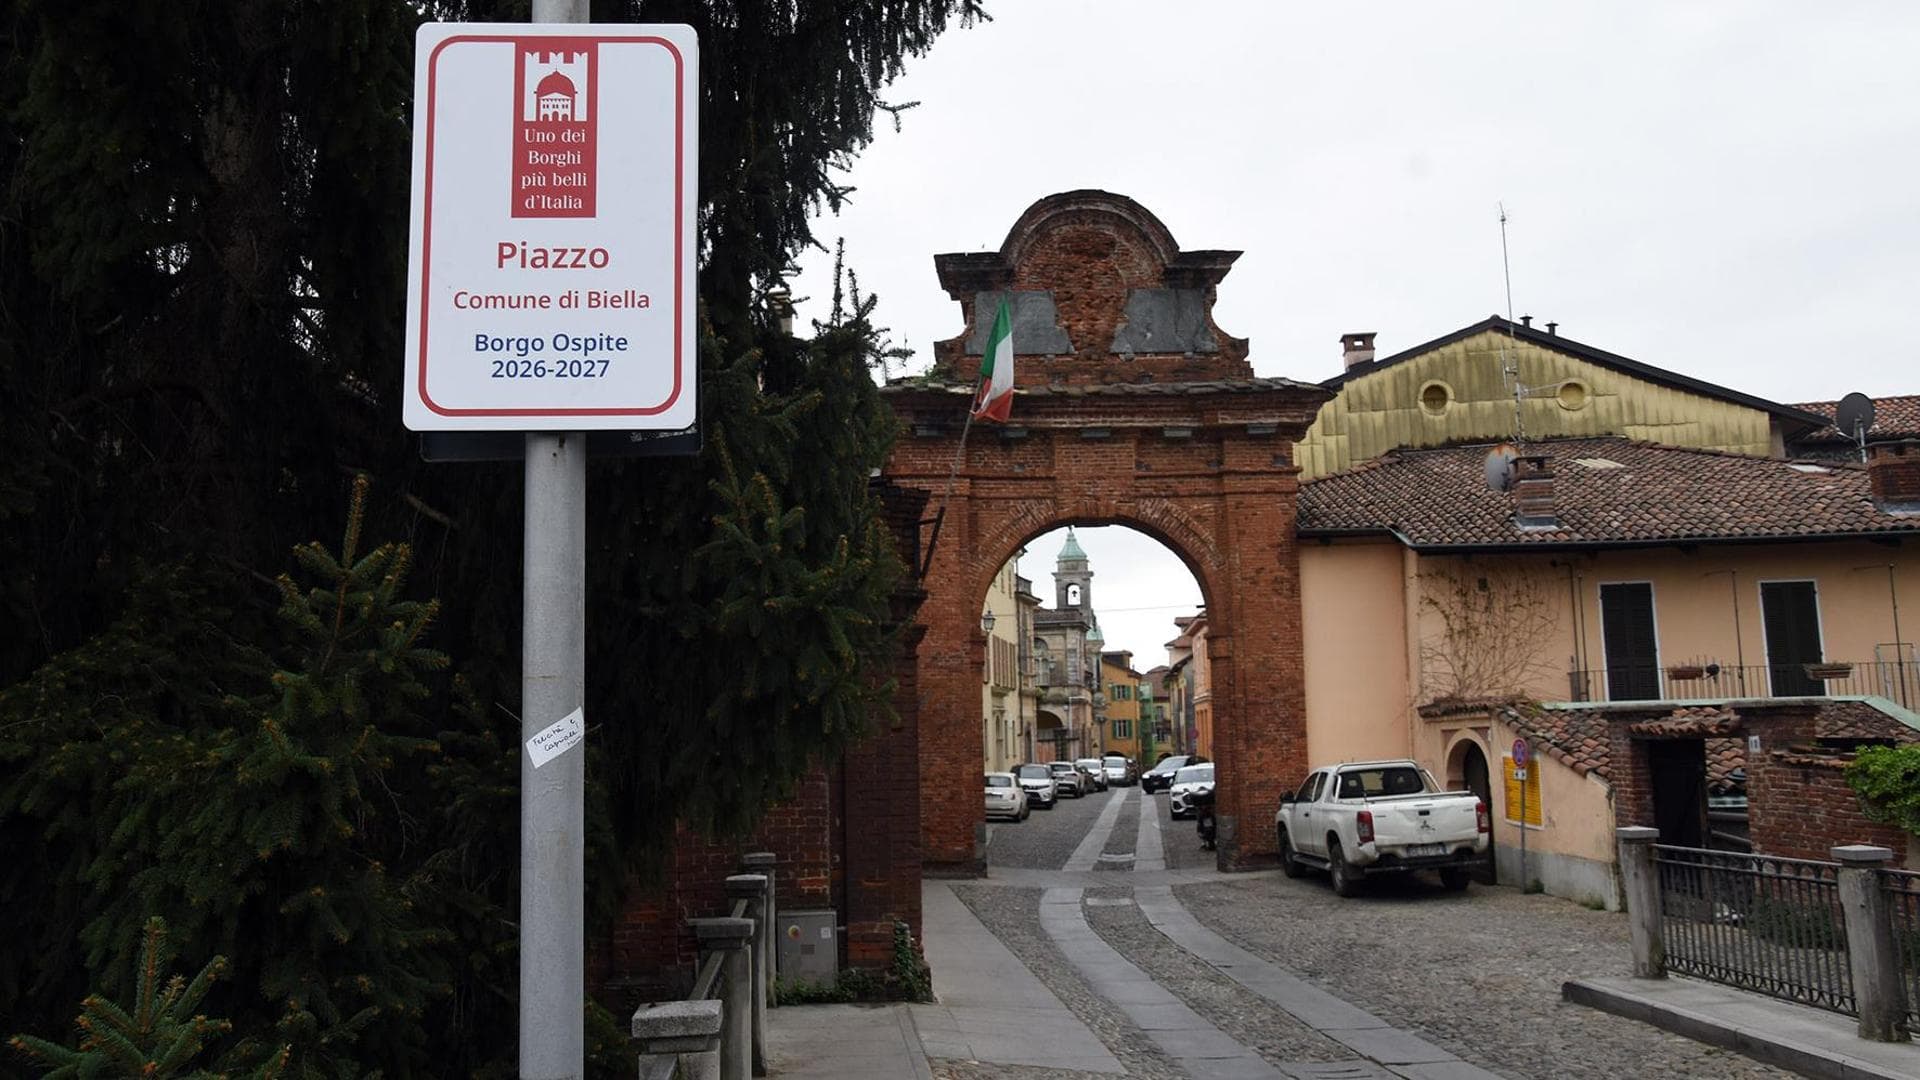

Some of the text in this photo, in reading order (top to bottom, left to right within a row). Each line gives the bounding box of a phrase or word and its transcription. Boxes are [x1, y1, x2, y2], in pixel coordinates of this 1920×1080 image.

[524, 128, 586, 143] Uno dei
[528, 150, 582, 168] Borghi
[521, 171, 587, 190] più belli
[524, 194, 583, 210] d'Italia
[497, 240, 610, 269] Piazzo
[453, 289, 650, 310] Comune di Biella
[474, 332, 628, 357] Borgo Ospite
[491, 359, 610, 378] 2026-2027
